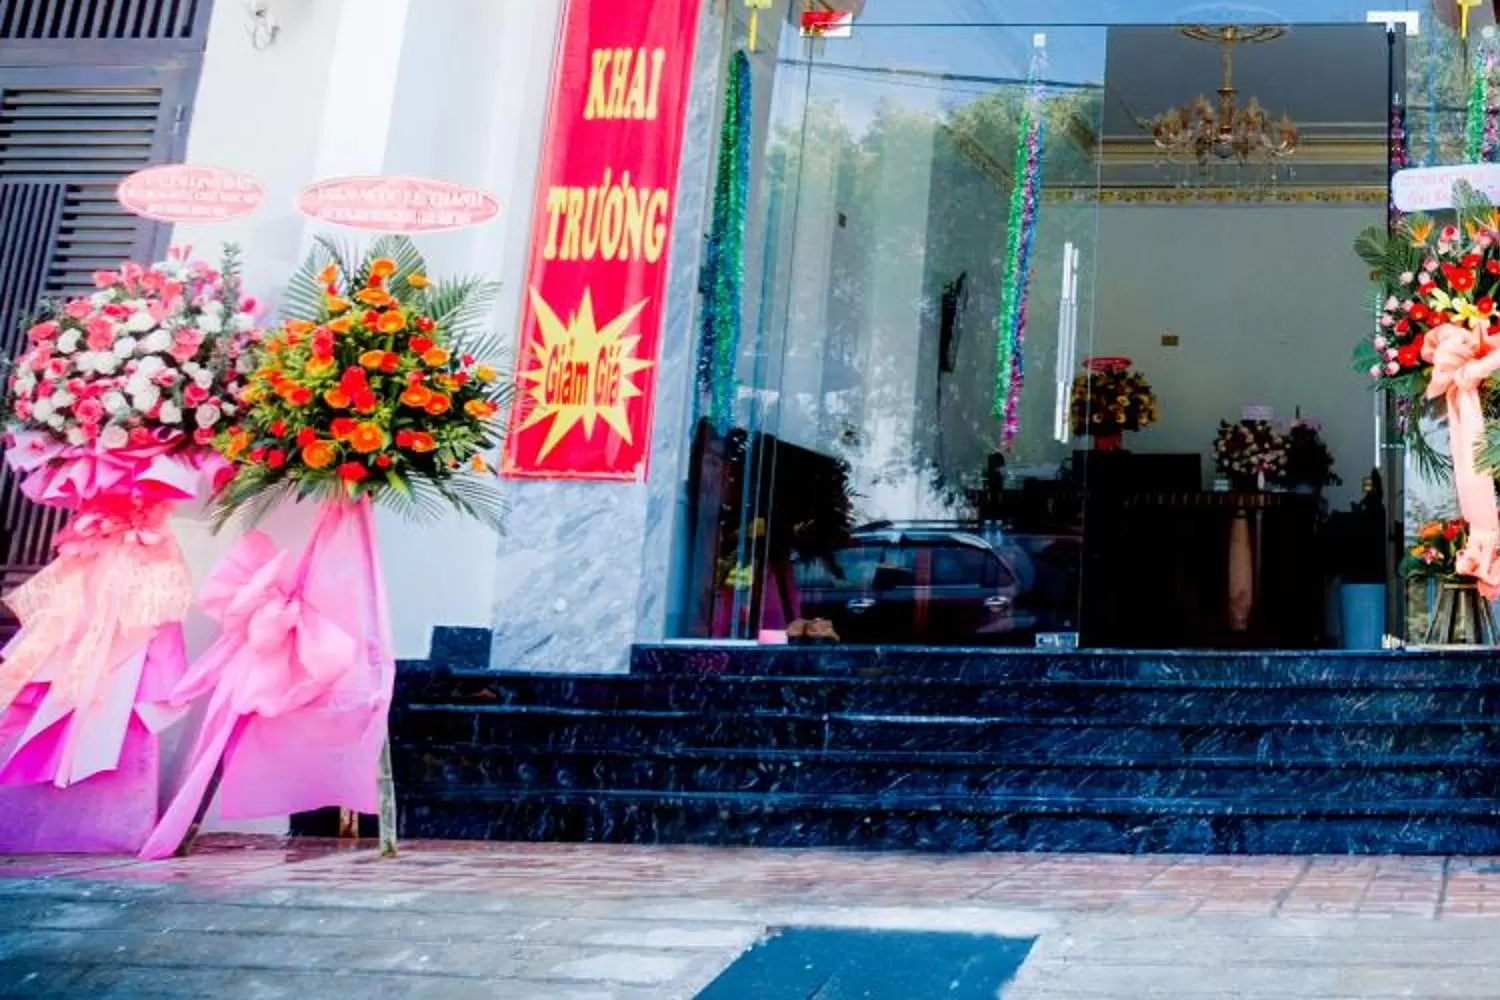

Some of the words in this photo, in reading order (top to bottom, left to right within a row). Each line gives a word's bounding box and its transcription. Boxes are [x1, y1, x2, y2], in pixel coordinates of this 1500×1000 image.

[583, 46, 666, 121] KHAI
[545, 337, 590, 406] Giảm
[594, 342, 623, 407] Giá
